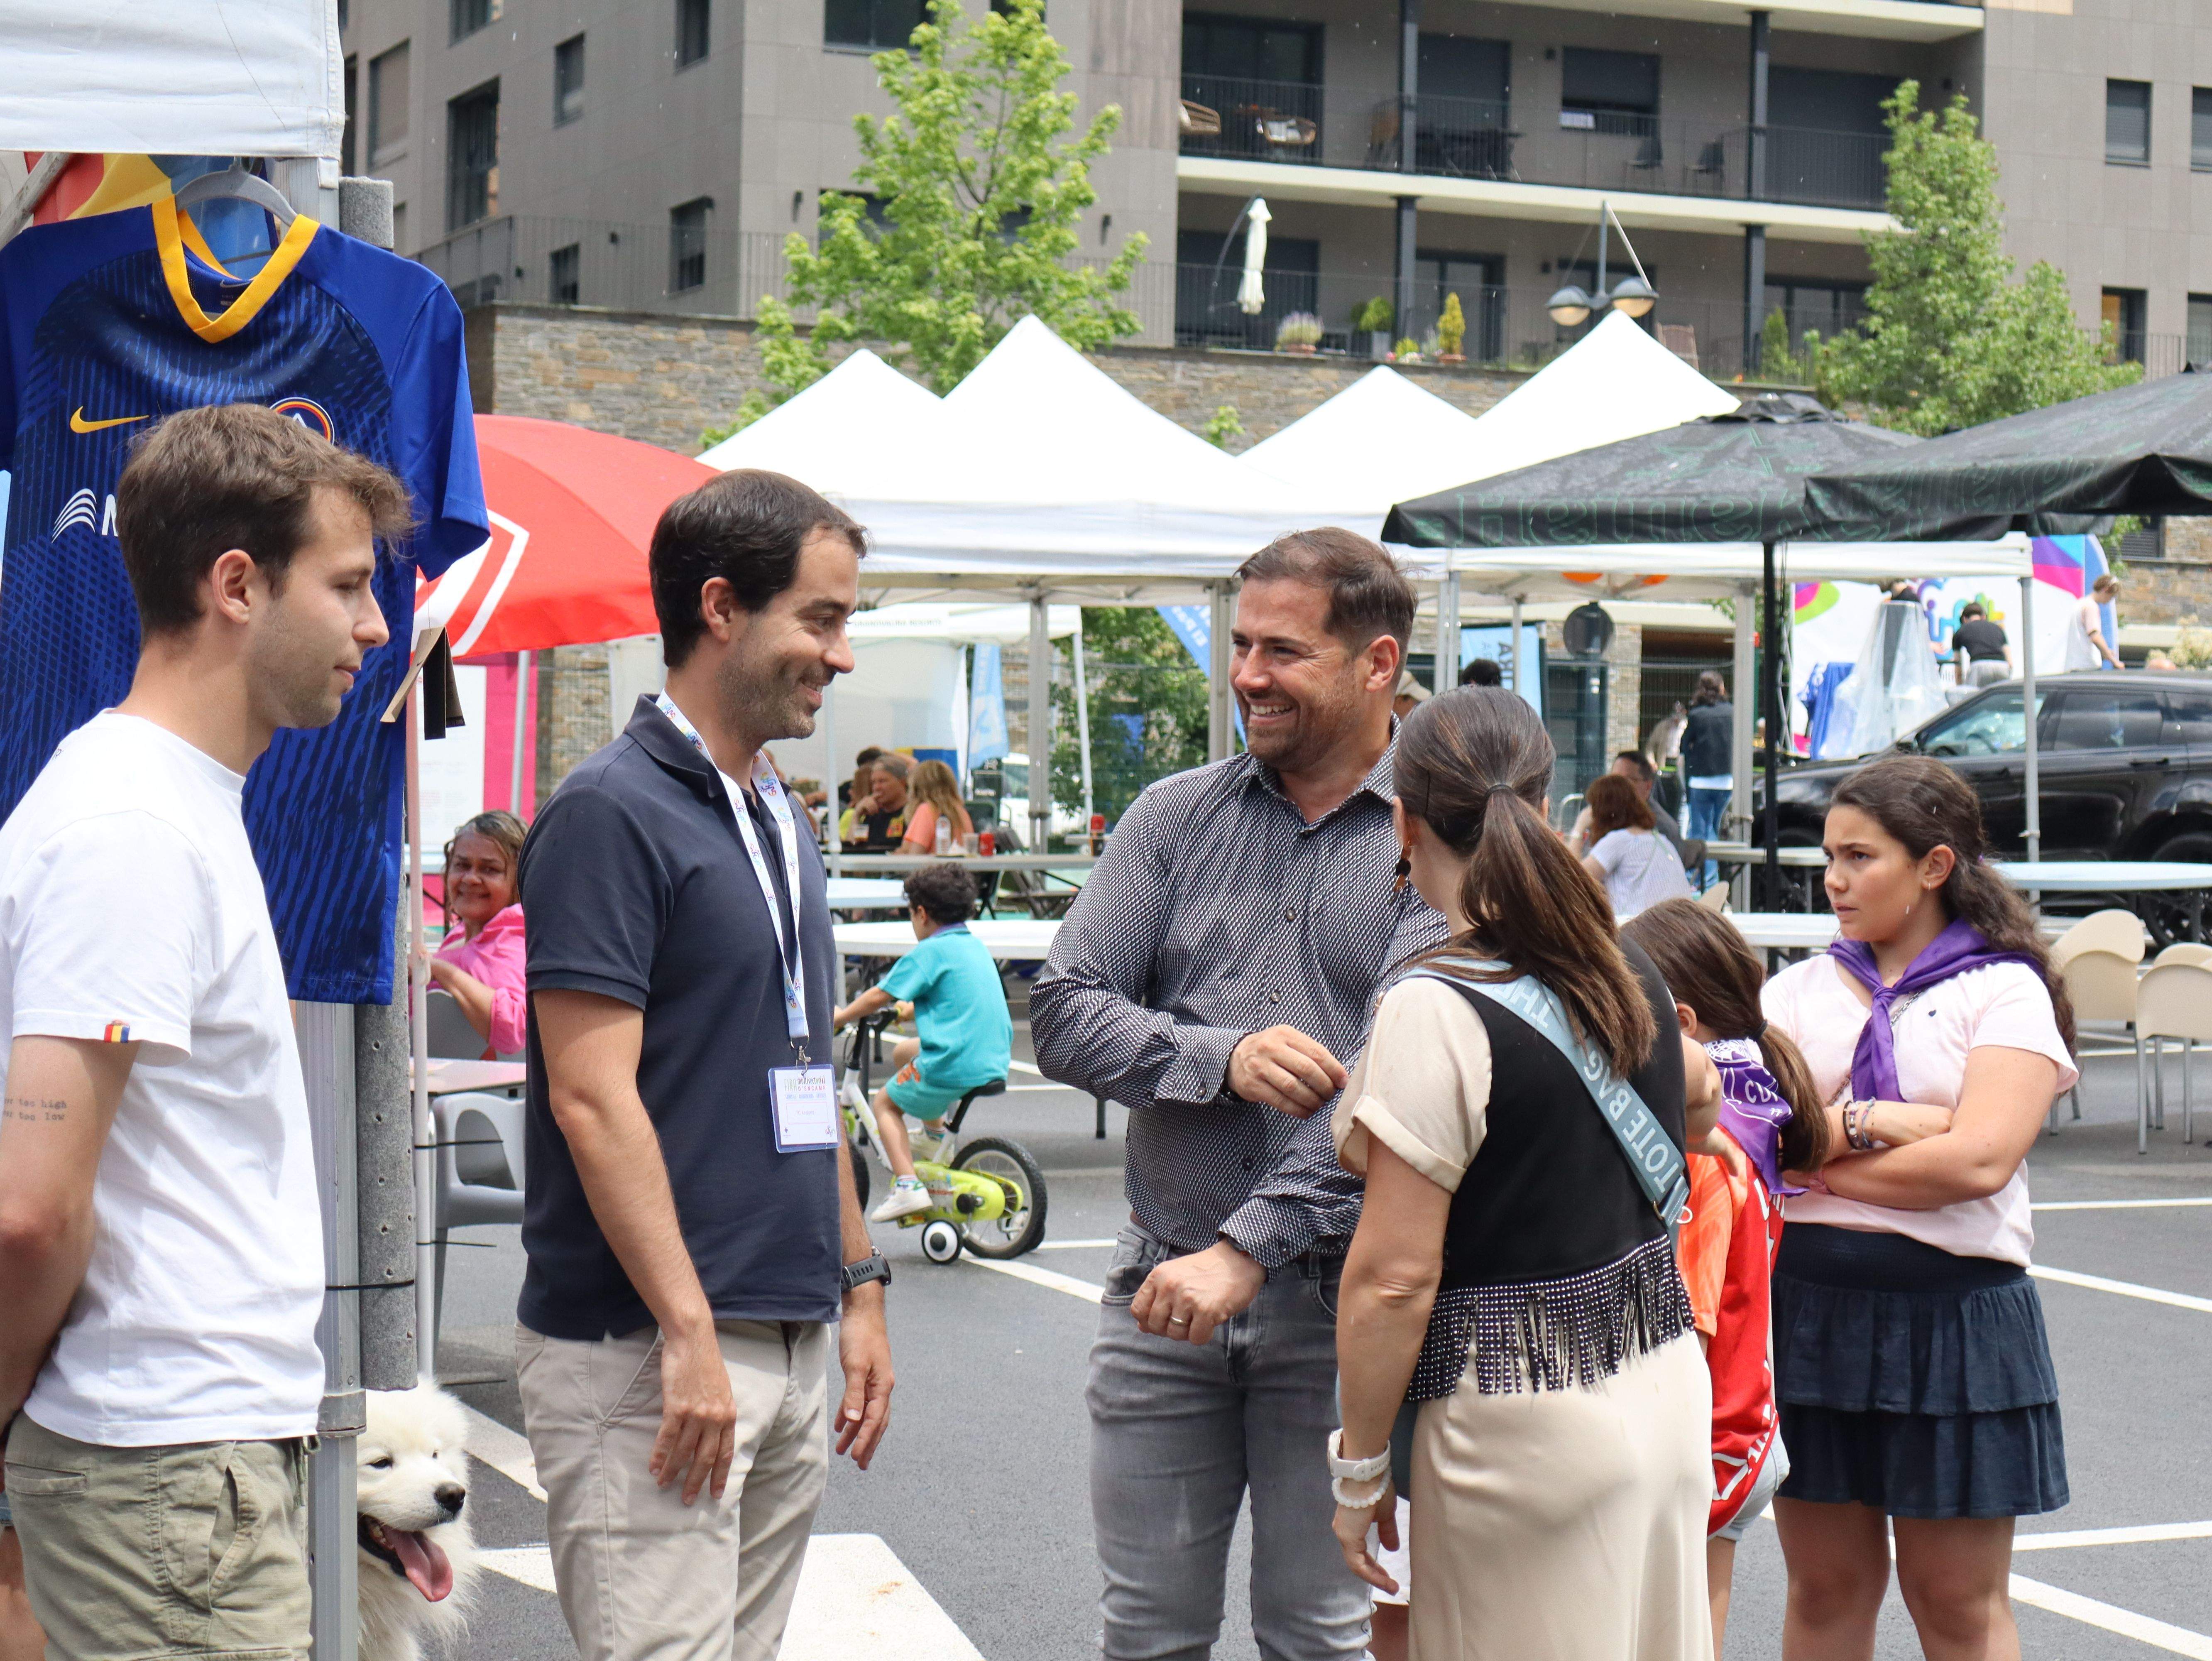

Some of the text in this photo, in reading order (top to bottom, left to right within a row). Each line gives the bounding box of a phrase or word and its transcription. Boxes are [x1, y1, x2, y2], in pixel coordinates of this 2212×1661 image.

[1453, 489, 1941, 546] Heinek
[41, 1100, 66, 1110] high
[45, 1112, 65, 1120] low
[1584, 1053, 1679, 1193] TOTE BAG
